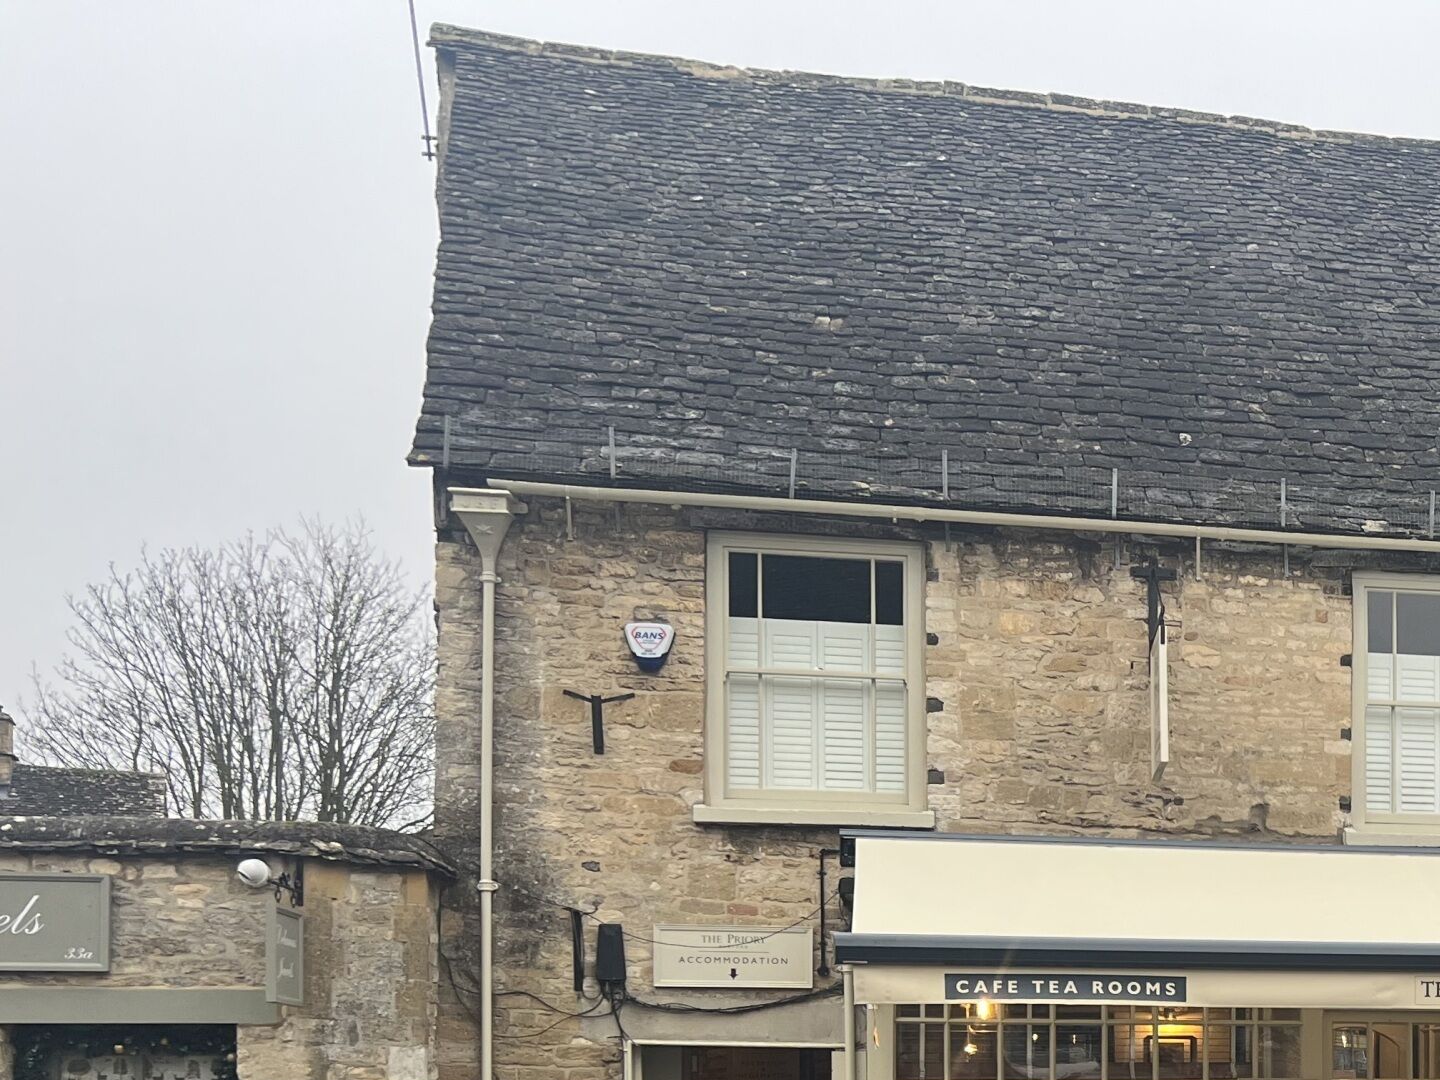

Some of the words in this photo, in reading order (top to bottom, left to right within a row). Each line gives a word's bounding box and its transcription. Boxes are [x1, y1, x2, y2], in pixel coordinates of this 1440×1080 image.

[635, 632, 664, 640] BANS
[702, 934, 723, 944] THE
[64, 947, 95, 960] 33a
[678, 956, 789, 965] ACCOMMODATION
[955, 979, 1019, 994] CAFE
[1032, 979, 1078, 994] TEA
[1092, 981, 1176, 996] ROOMS
